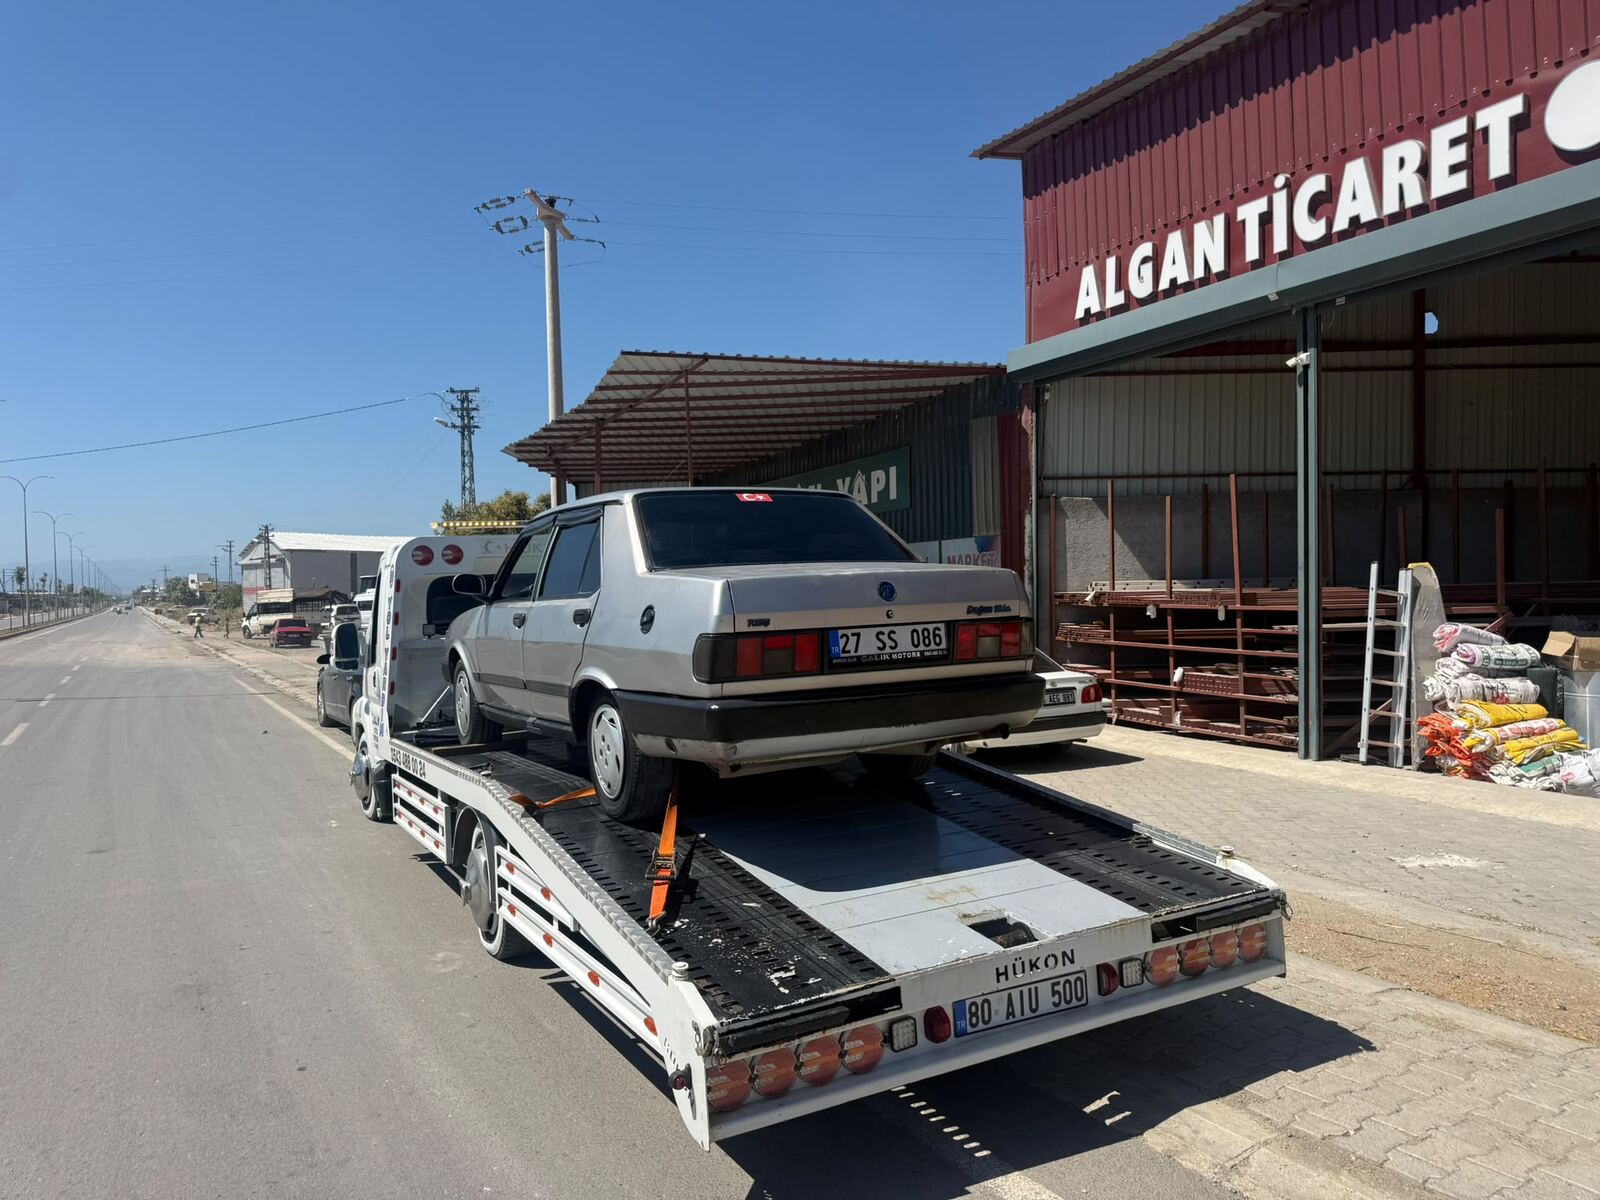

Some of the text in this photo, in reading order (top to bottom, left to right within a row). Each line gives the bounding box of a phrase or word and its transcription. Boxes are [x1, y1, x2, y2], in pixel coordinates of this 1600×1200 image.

[1074, 213, 1229, 320] ALGAN
[840, 632, 861, 654] 27
[875, 629, 898, 652] SS
[910, 626, 943, 649] 086
[891, 651, 921, 660] MOTORS
[995, 948, 1076, 984] HÜKON
[956, 975, 1085, 1029] TR 80 AIU 500
